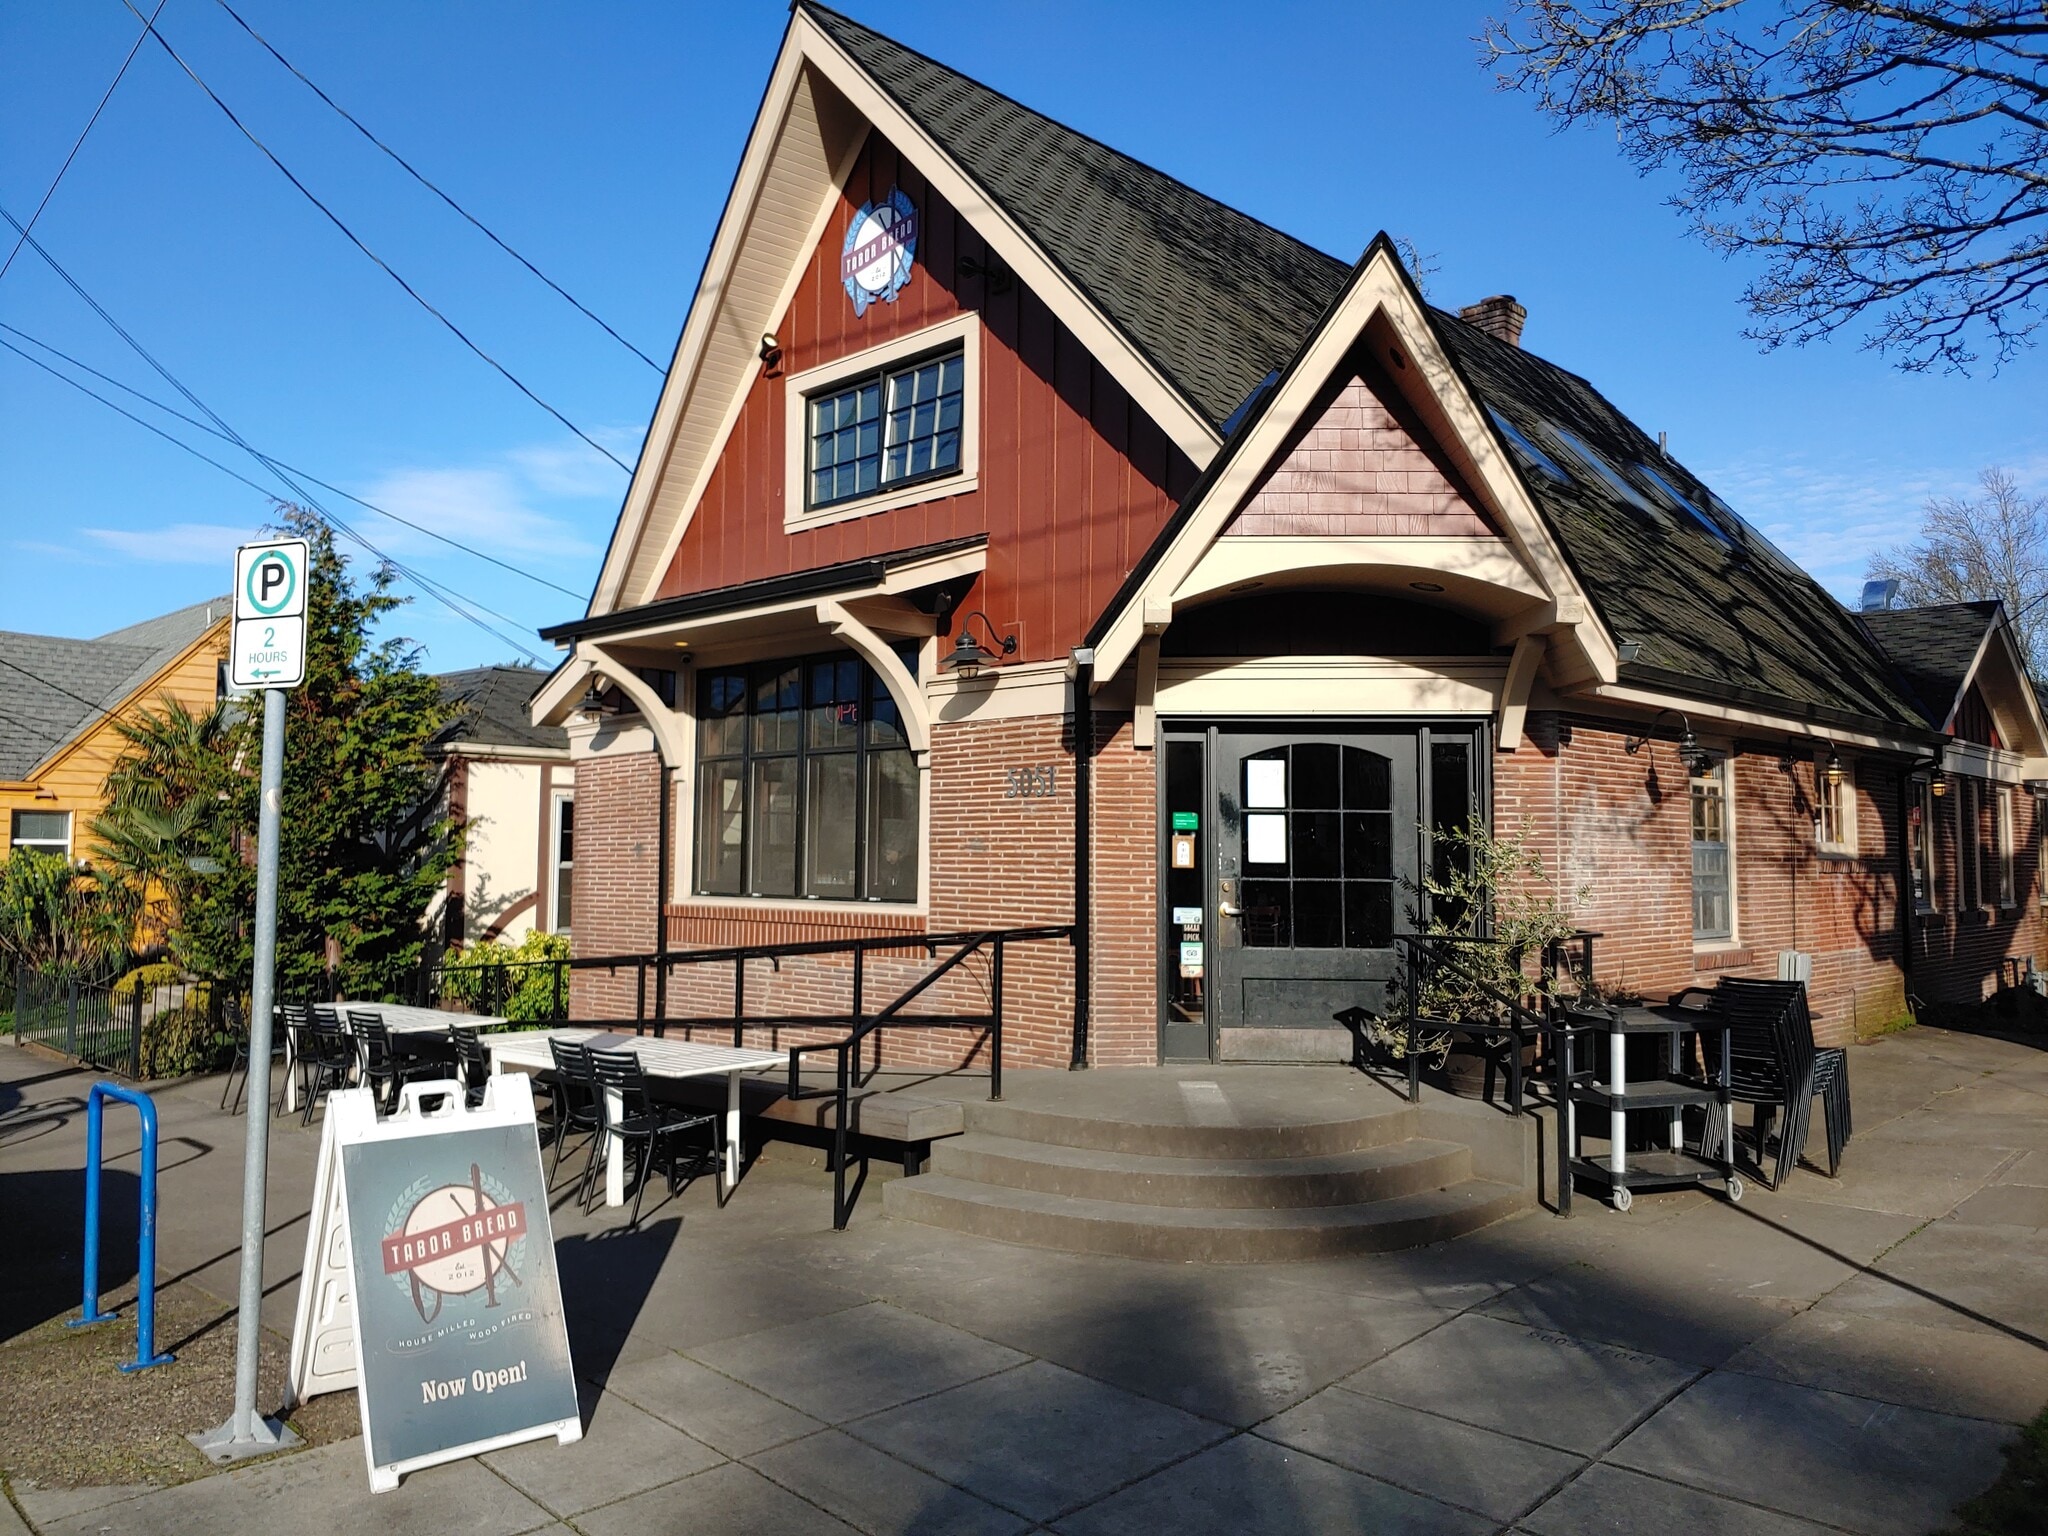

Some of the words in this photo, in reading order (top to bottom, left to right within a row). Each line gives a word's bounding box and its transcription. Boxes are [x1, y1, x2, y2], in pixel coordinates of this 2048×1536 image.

[846, 243, 877, 273] TABOR
[881, 219, 913, 251] BREAD
[261, 563, 285, 602] P
[263, 627, 275, 648] 2
[249, 650, 288, 664] HOURS
[1007, 766, 1056, 798] 5051
[391, 1231, 451, 1265] TABOR
[462, 1210, 517, 1243] BREAD
[448, 1270, 475, 1280] 2012
[398, 1333, 433, 1348] HOUSE
[437, 1318, 476, 1338] MILLED
[469, 1325, 498, 1340] WOOD
[501, 1312, 532, 1327] FIRED
[421, 1377, 466, 1404] Now
[472, 1360, 528, 1393] Open!
